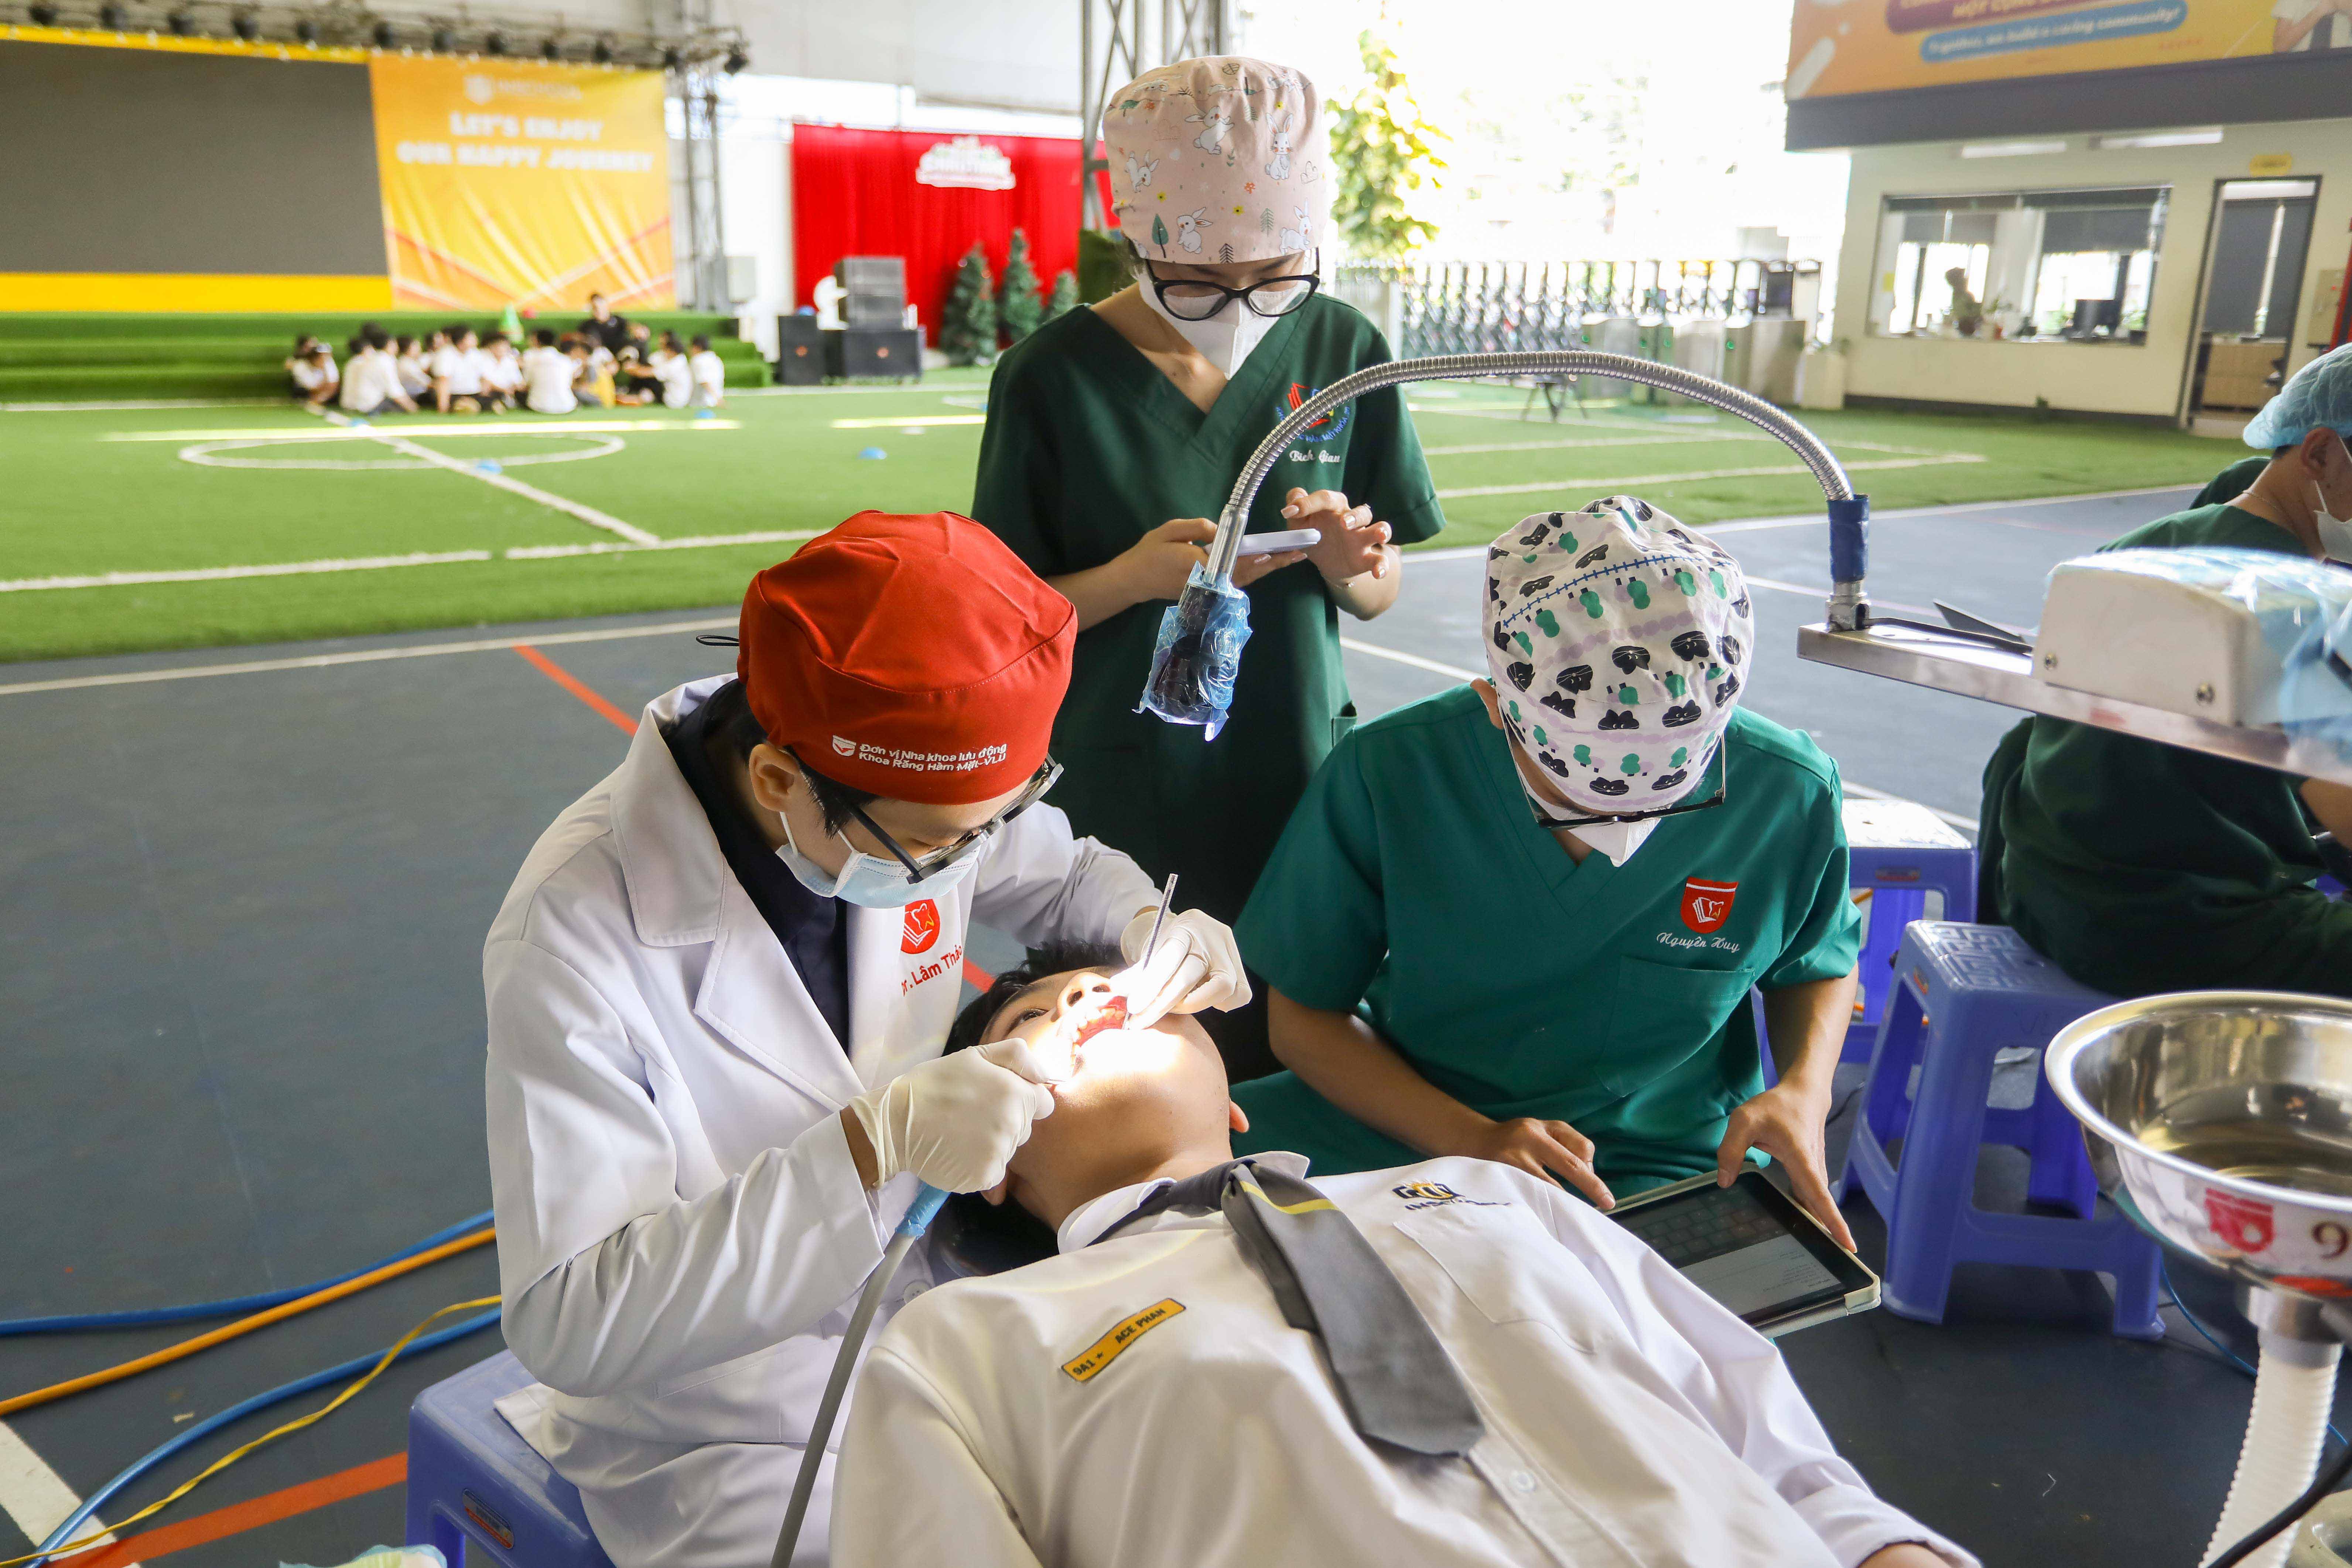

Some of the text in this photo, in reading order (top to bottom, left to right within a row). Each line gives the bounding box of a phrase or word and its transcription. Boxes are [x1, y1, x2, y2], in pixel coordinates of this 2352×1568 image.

[449, 112, 603, 141] LET'S ENJOY
[396, 141, 654, 173] OUR HAPPY JOURNEY
[859, 743, 886, 755] Đơn
[901, 750, 925, 761] Nha
[926, 752, 957, 762] khoa
[958, 751, 976, 762] lưu
[978, 743, 1007, 759] động
[859, 751, 890, 765] Khoa
[892, 759, 924, 772] Răng
[927, 762, 954, 771] Hàm
[1711, 937, 1740, 953] Huy
[911, 963, 942, 985] Lâm
[940, 944, 962, 969] Thảo
[1115, 1325, 1137, 1344] ACE
